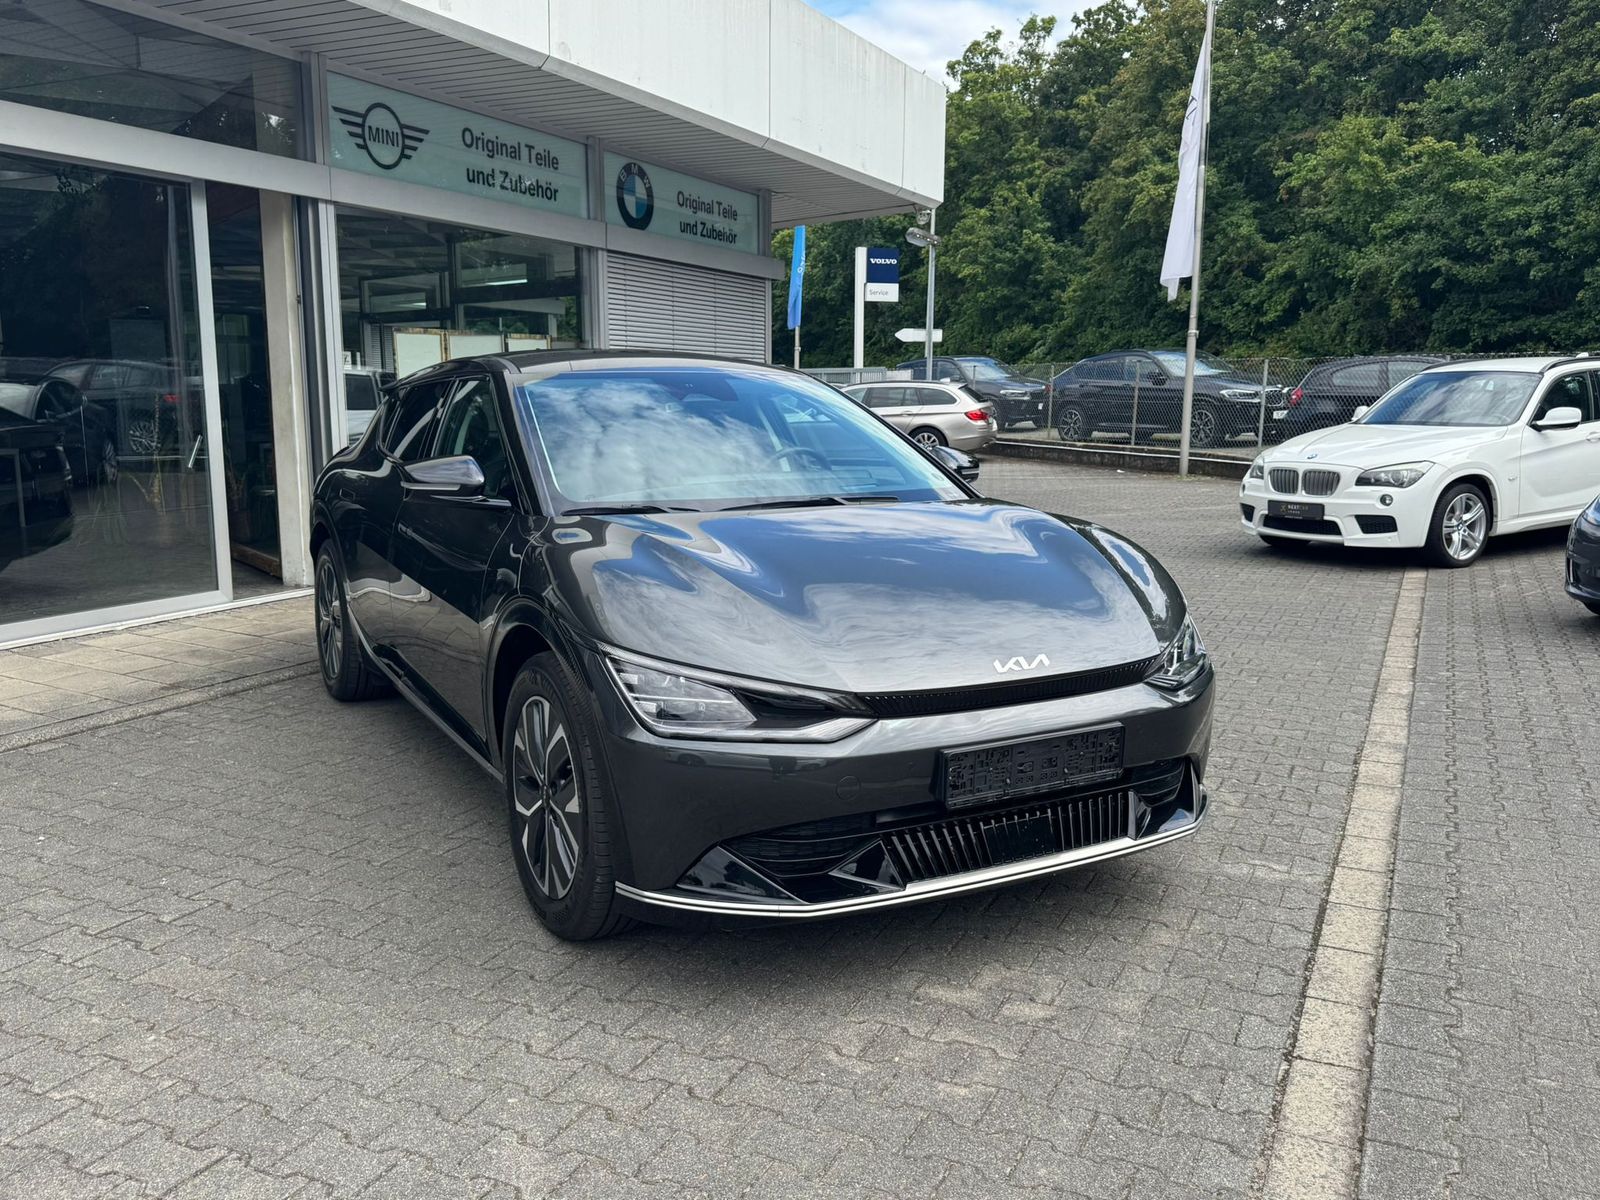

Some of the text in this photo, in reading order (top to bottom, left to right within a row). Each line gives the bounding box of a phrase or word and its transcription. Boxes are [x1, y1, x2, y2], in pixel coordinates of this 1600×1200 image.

[368, 125, 399, 147] MINI
[462, 127, 559, 170] Original Teile
[466, 168, 559, 201] und Zubehör
[620, 164, 651, 188] BMW
[677, 190, 738, 221] Original Teile
[680, 221, 738, 244] und Zubehör
